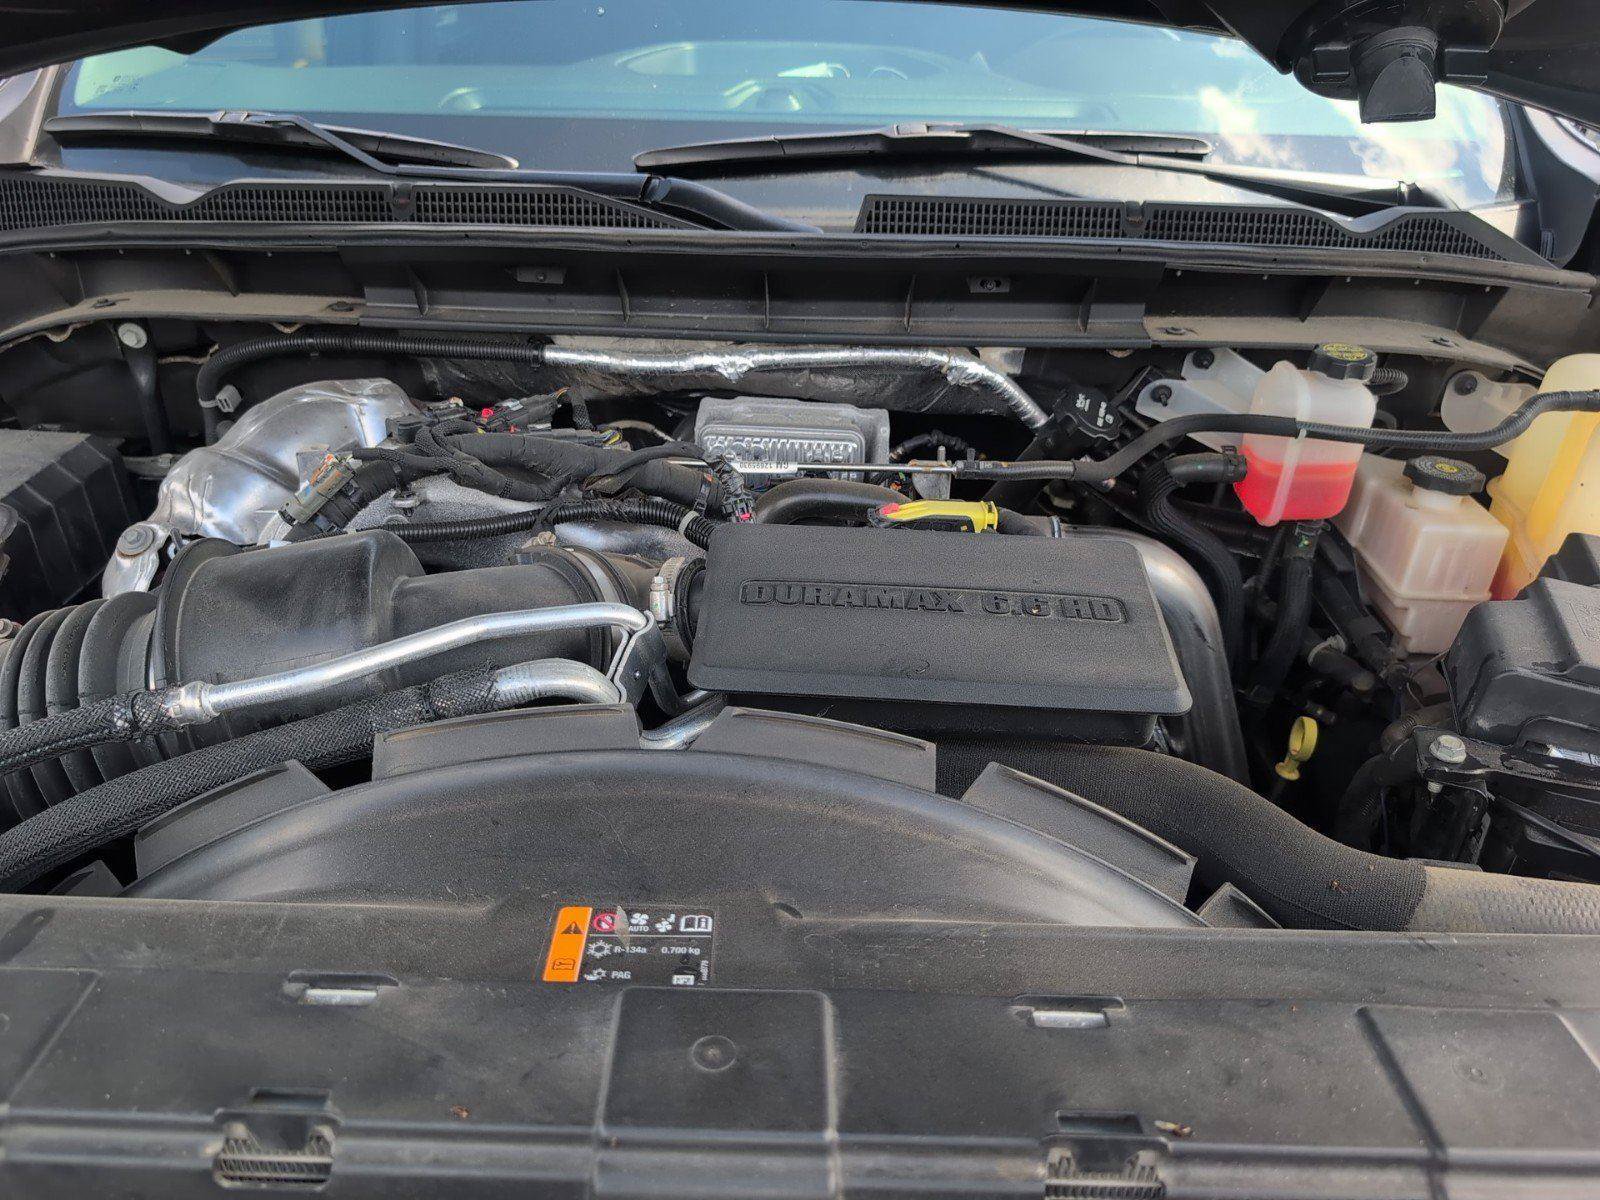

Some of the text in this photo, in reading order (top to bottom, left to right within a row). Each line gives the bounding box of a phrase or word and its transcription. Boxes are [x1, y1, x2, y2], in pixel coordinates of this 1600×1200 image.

[775, 461, 789, 469] GM
[742, 584, 1123, 622] DURAMAX 6.6 HD
[614, 945, 701, 956] R-134a 0.700 kg
[611, 970, 632, 980] PAG
